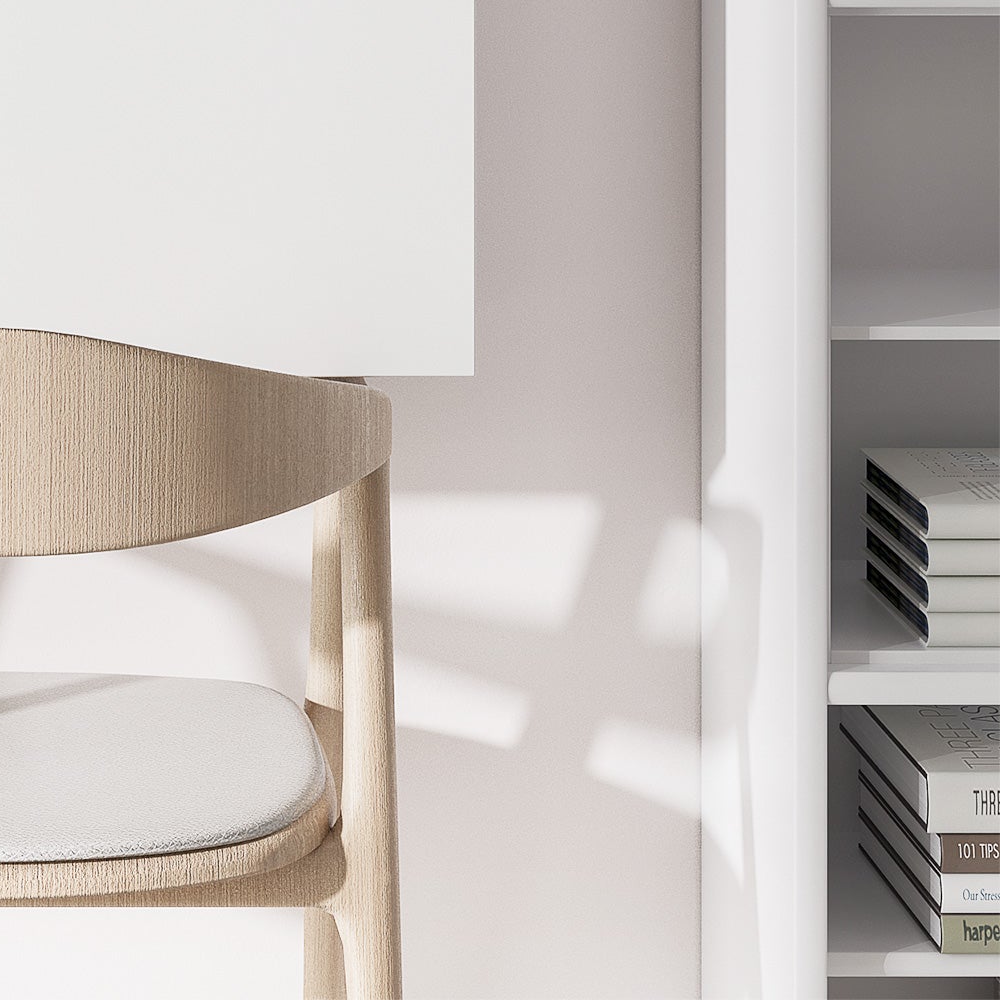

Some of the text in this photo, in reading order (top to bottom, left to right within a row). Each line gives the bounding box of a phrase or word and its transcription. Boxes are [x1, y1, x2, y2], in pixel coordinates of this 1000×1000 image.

[957, 843, 1000, 859] 101 TIPS
[962, 888, 978, 901] Our
[962, 919, 1000, 946] harpe
